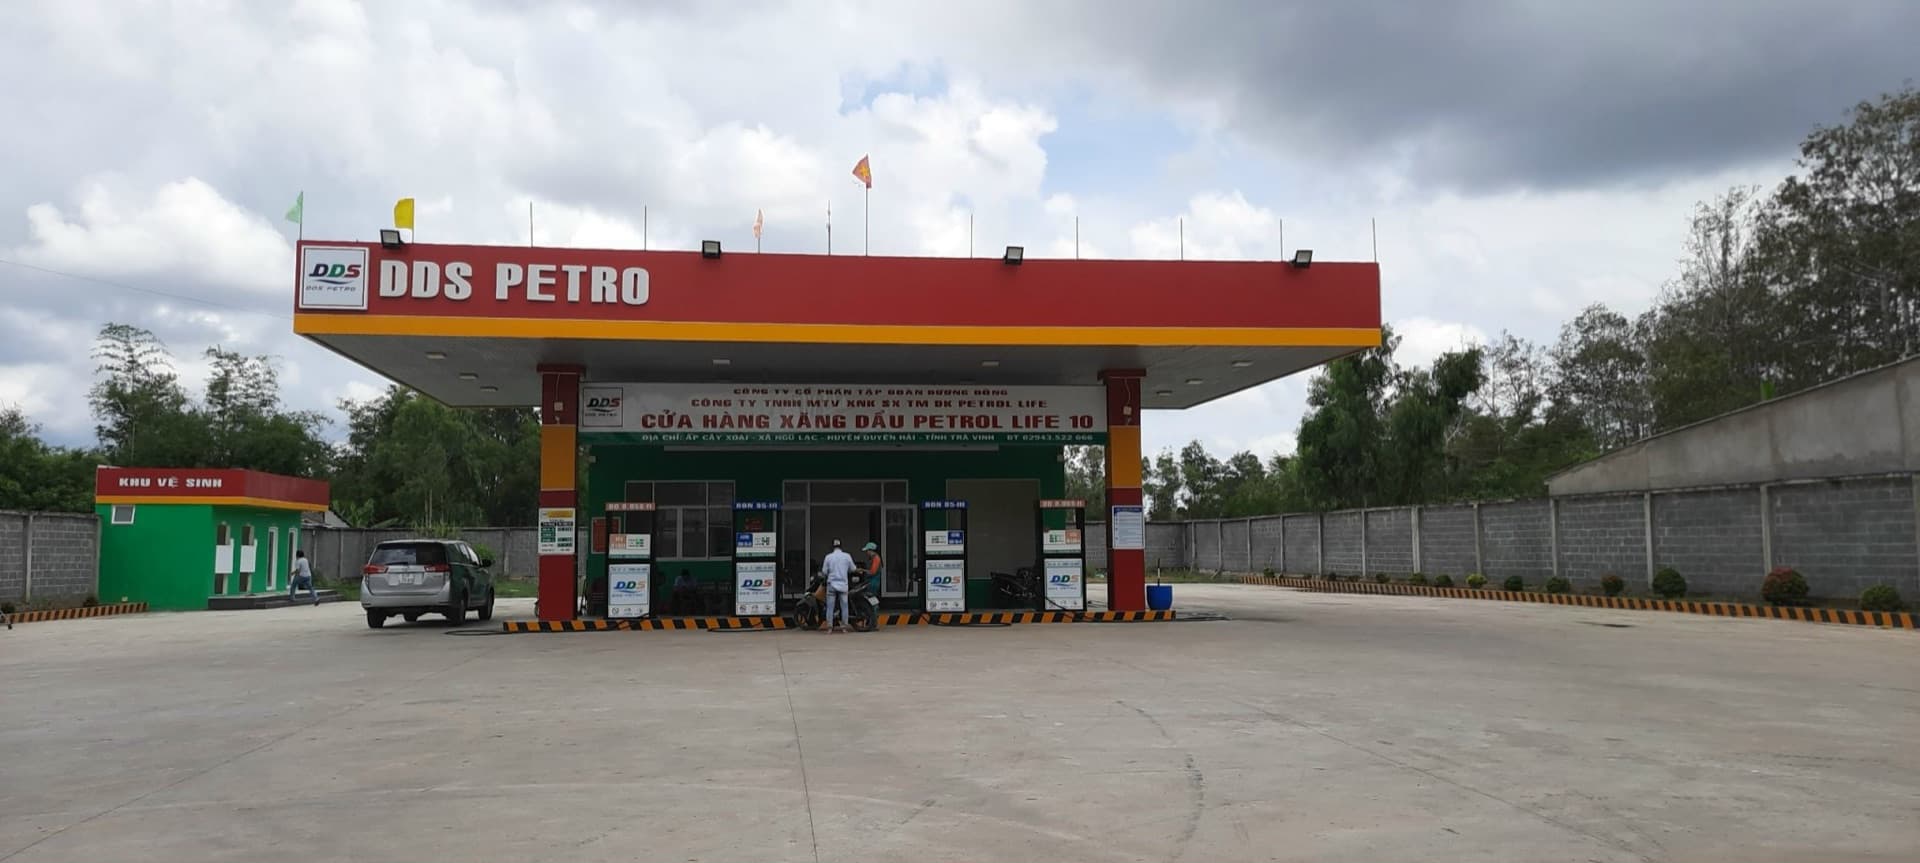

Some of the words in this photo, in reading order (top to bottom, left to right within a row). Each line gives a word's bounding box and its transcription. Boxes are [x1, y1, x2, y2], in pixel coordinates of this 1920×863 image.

[309, 263, 362, 278] DDS
[380, 260, 473, 300] DDS
[495, 263, 651, 305] PETRO
[587, 398, 621, 408] DDS
[691, 399, 732, 407] CÔNG
[764, 400, 802, 408] TNHH
[807, 400, 840, 408] MTV
[847, 400, 876, 408] XNK
[881, 400, 901, 408] SX
[908, 400, 929, 408] TM
[959, 400, 1013, 408] PETROL
[1018, 400, 1048, 408] LIFE
[641, 409, 693, 429] CỬA
[703, 411, 770, 429] HÀNG
[780, 412, 847, 429] XĂNG
[856, 410, 905, 429] DẦU
[913, 415, 1004, 429] PETROL
[1012, 415, 1061, 429] LIFE
[1070, 415, 1094, 429] 10
[119, 478, 151, 487] KHU
[186, 478, 222, 488] SINH
[741, 579, 773, 587] DDS
[930, 576, 961, 584] DDS
[1049, 574, 1080, 583] DDS
[614, 581, 646, 590] DDS
